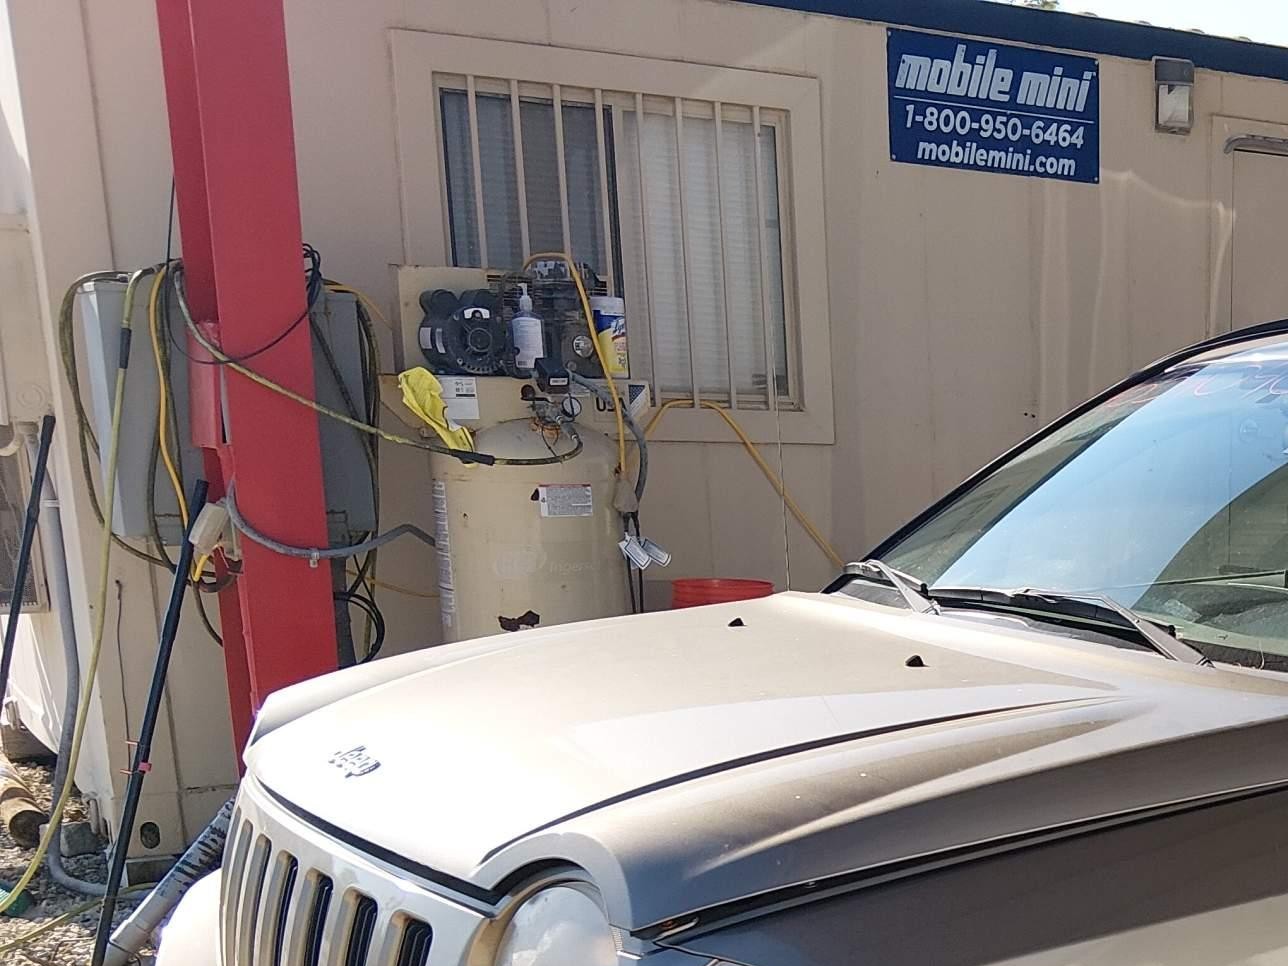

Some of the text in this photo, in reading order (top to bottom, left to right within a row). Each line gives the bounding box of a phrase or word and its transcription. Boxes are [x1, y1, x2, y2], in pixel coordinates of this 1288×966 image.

[895, 44, 1093, 112] mobile mini
[905, 104, 1084, 149] 1-800-950-6464
[917, 139, 1075, 176] mobilemini.com
